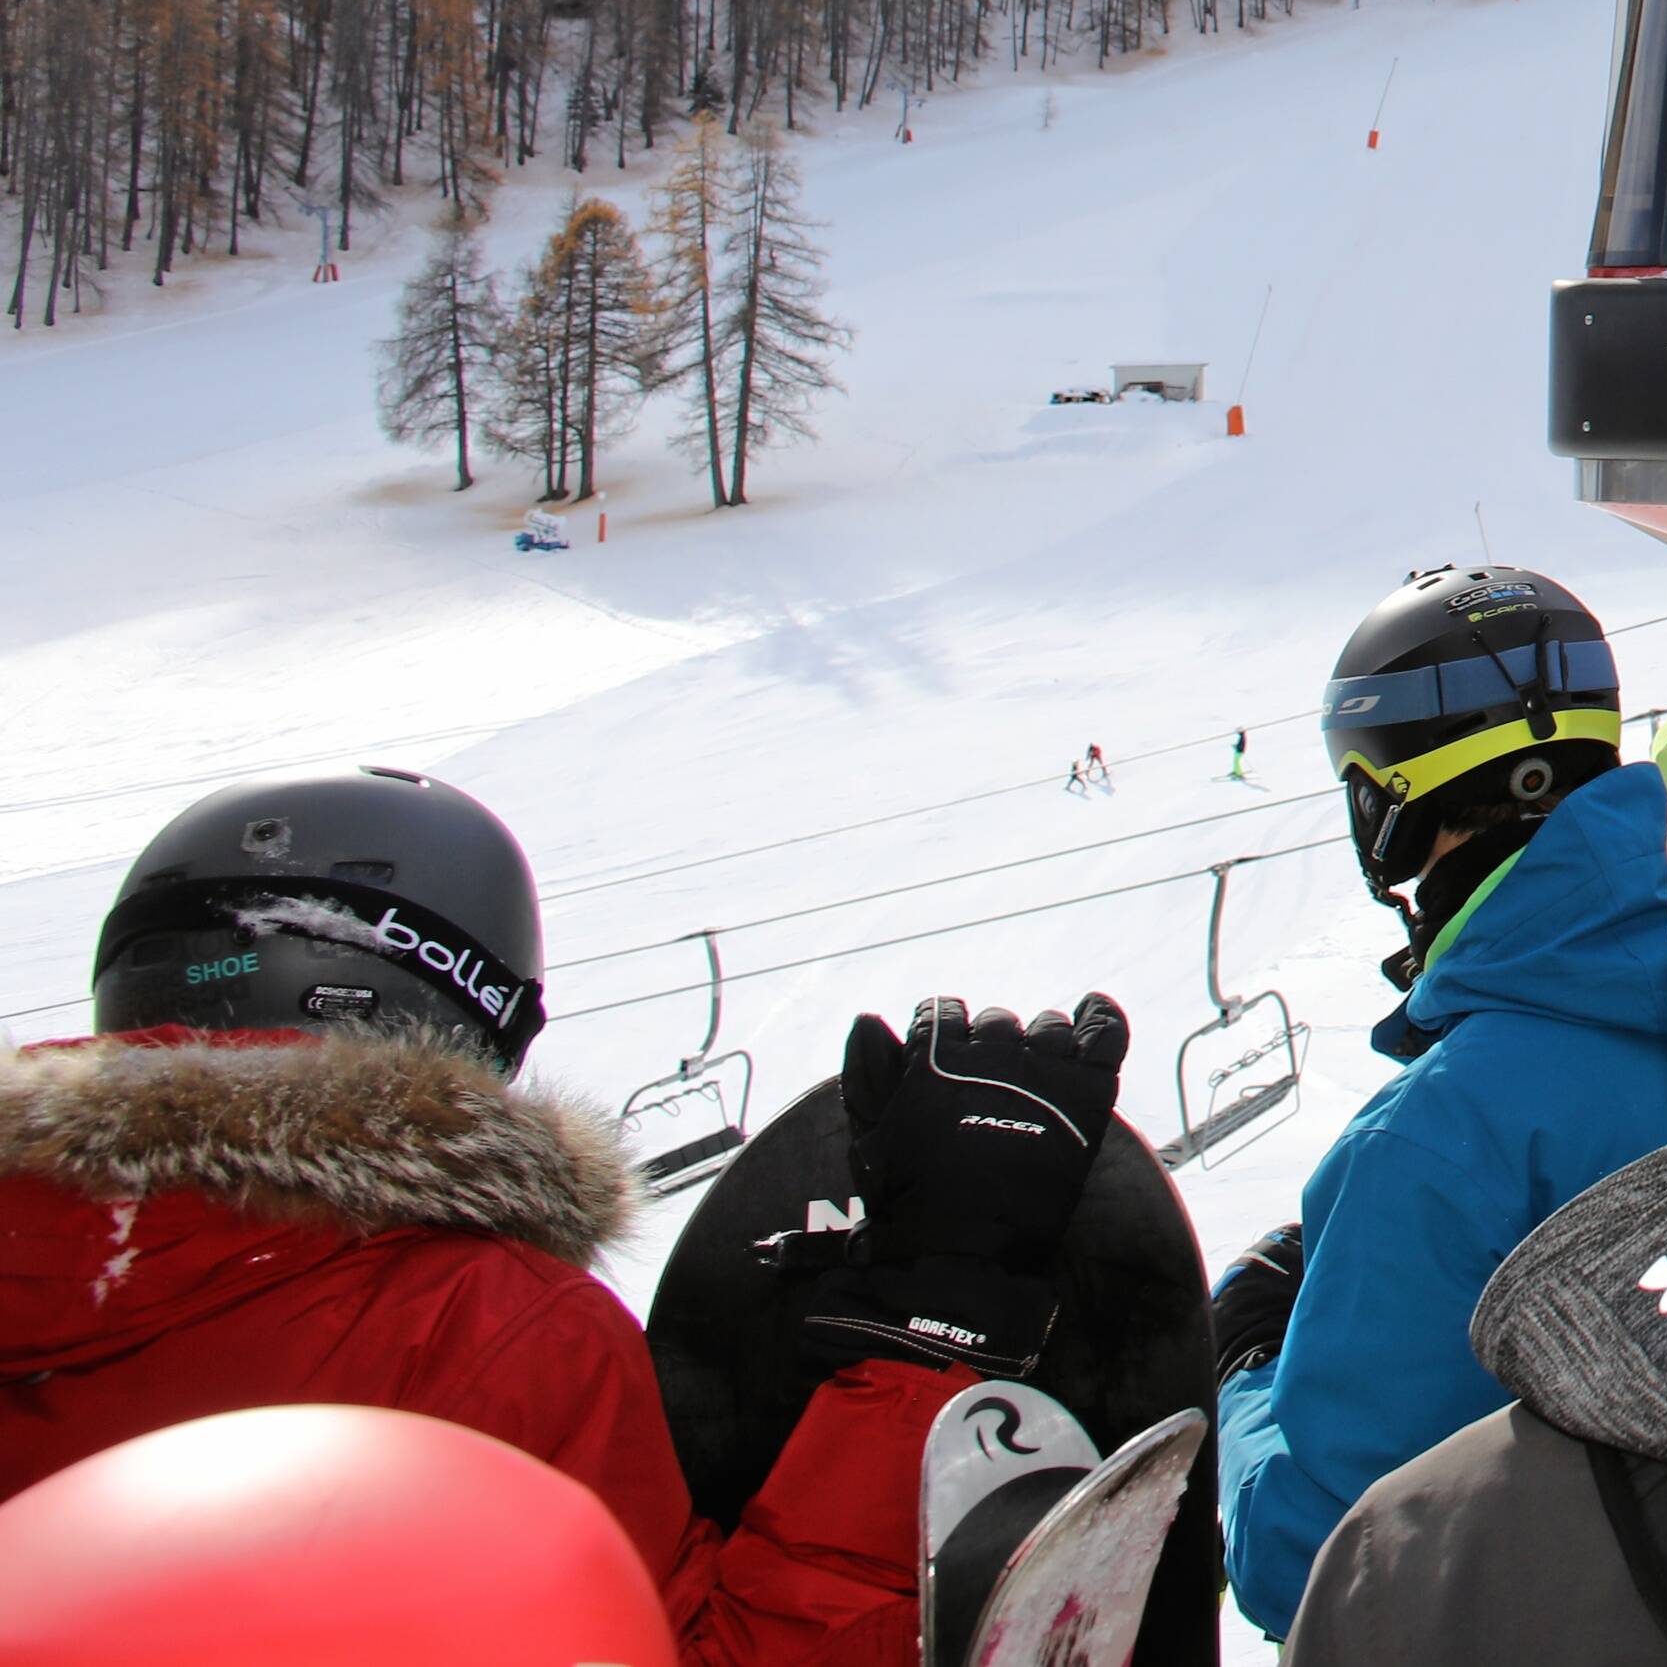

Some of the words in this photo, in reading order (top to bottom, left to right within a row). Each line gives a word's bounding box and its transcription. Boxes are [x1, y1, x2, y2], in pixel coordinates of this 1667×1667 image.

[1449, 582, 1532, 607] GoPro
[185, 952, 261, 985] SHOE
[375, 908, 510, 1017] bollé
[960, 1115, 1047, 1135] RACER
